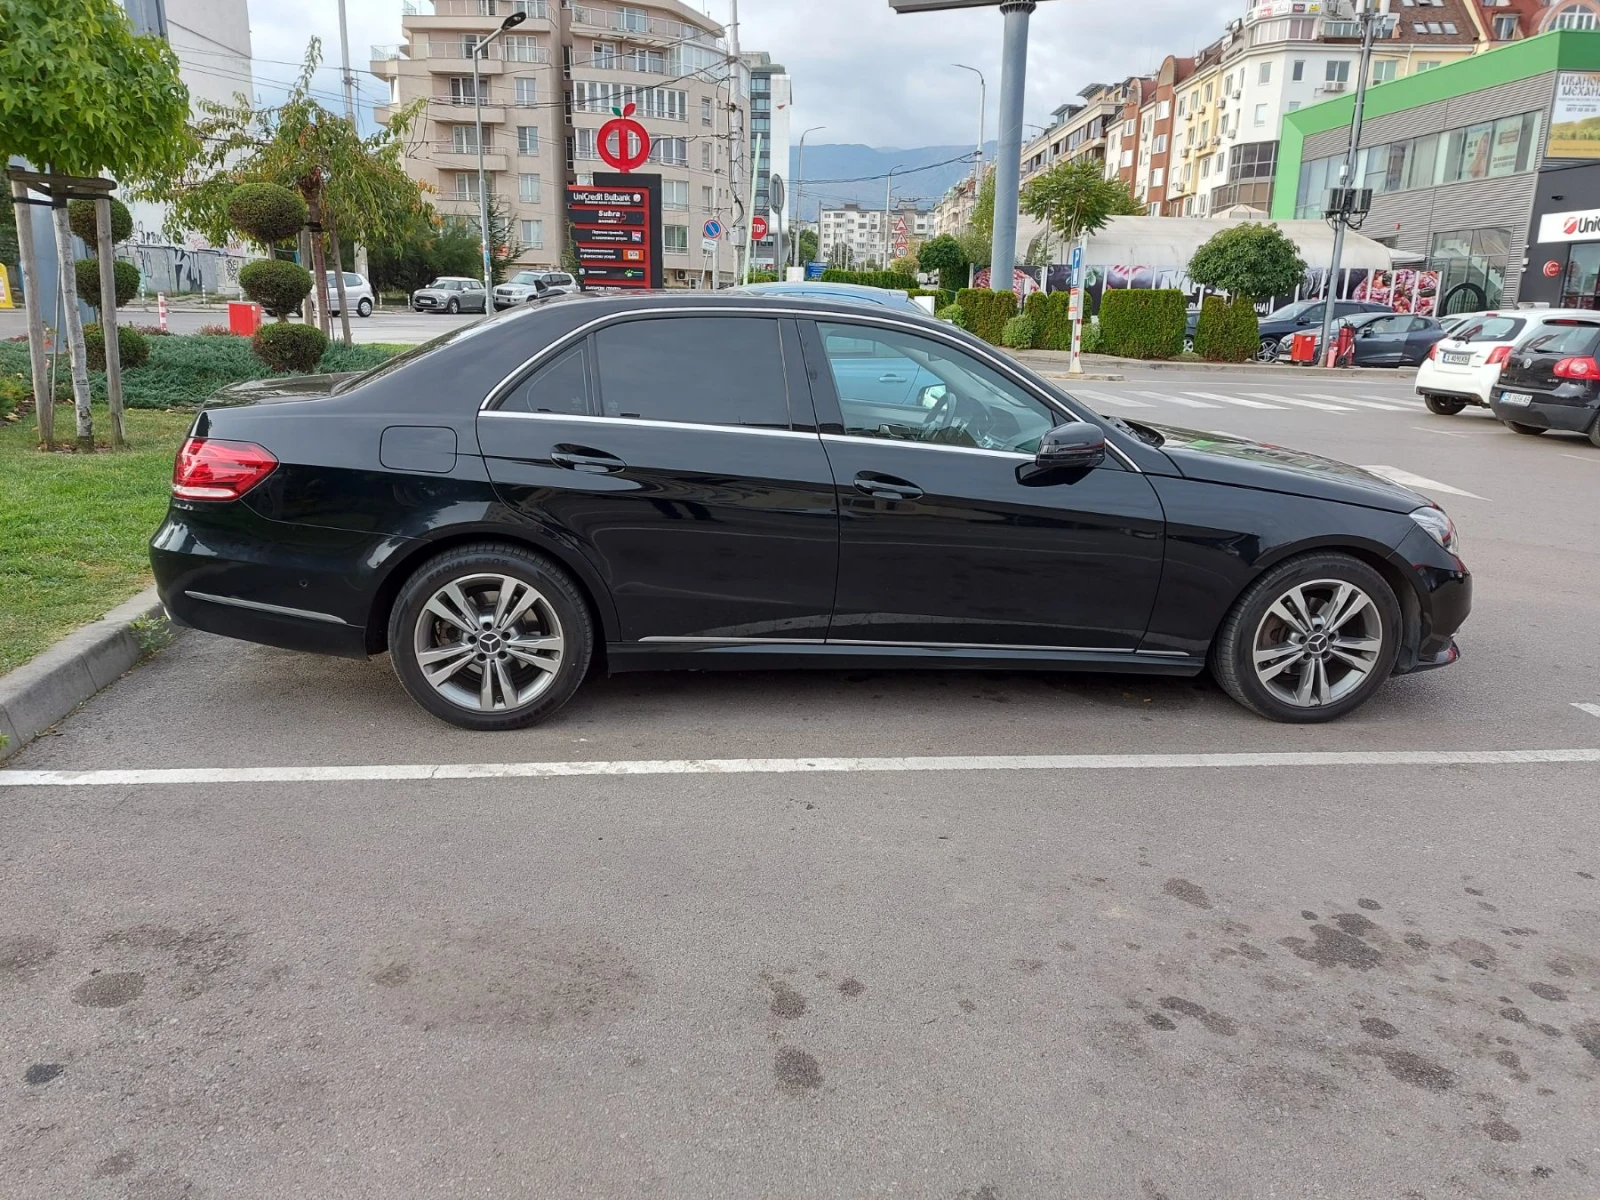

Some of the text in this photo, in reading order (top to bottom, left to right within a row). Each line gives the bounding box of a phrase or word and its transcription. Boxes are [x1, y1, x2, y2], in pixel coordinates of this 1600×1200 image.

[1562, 86, 1600, 97] МЕХАН
[573, 192, 631, 202] UniCredit Bulbank
[752, 224, 765, 233] TOP
[427, 560, 471, 583] RADIAL
